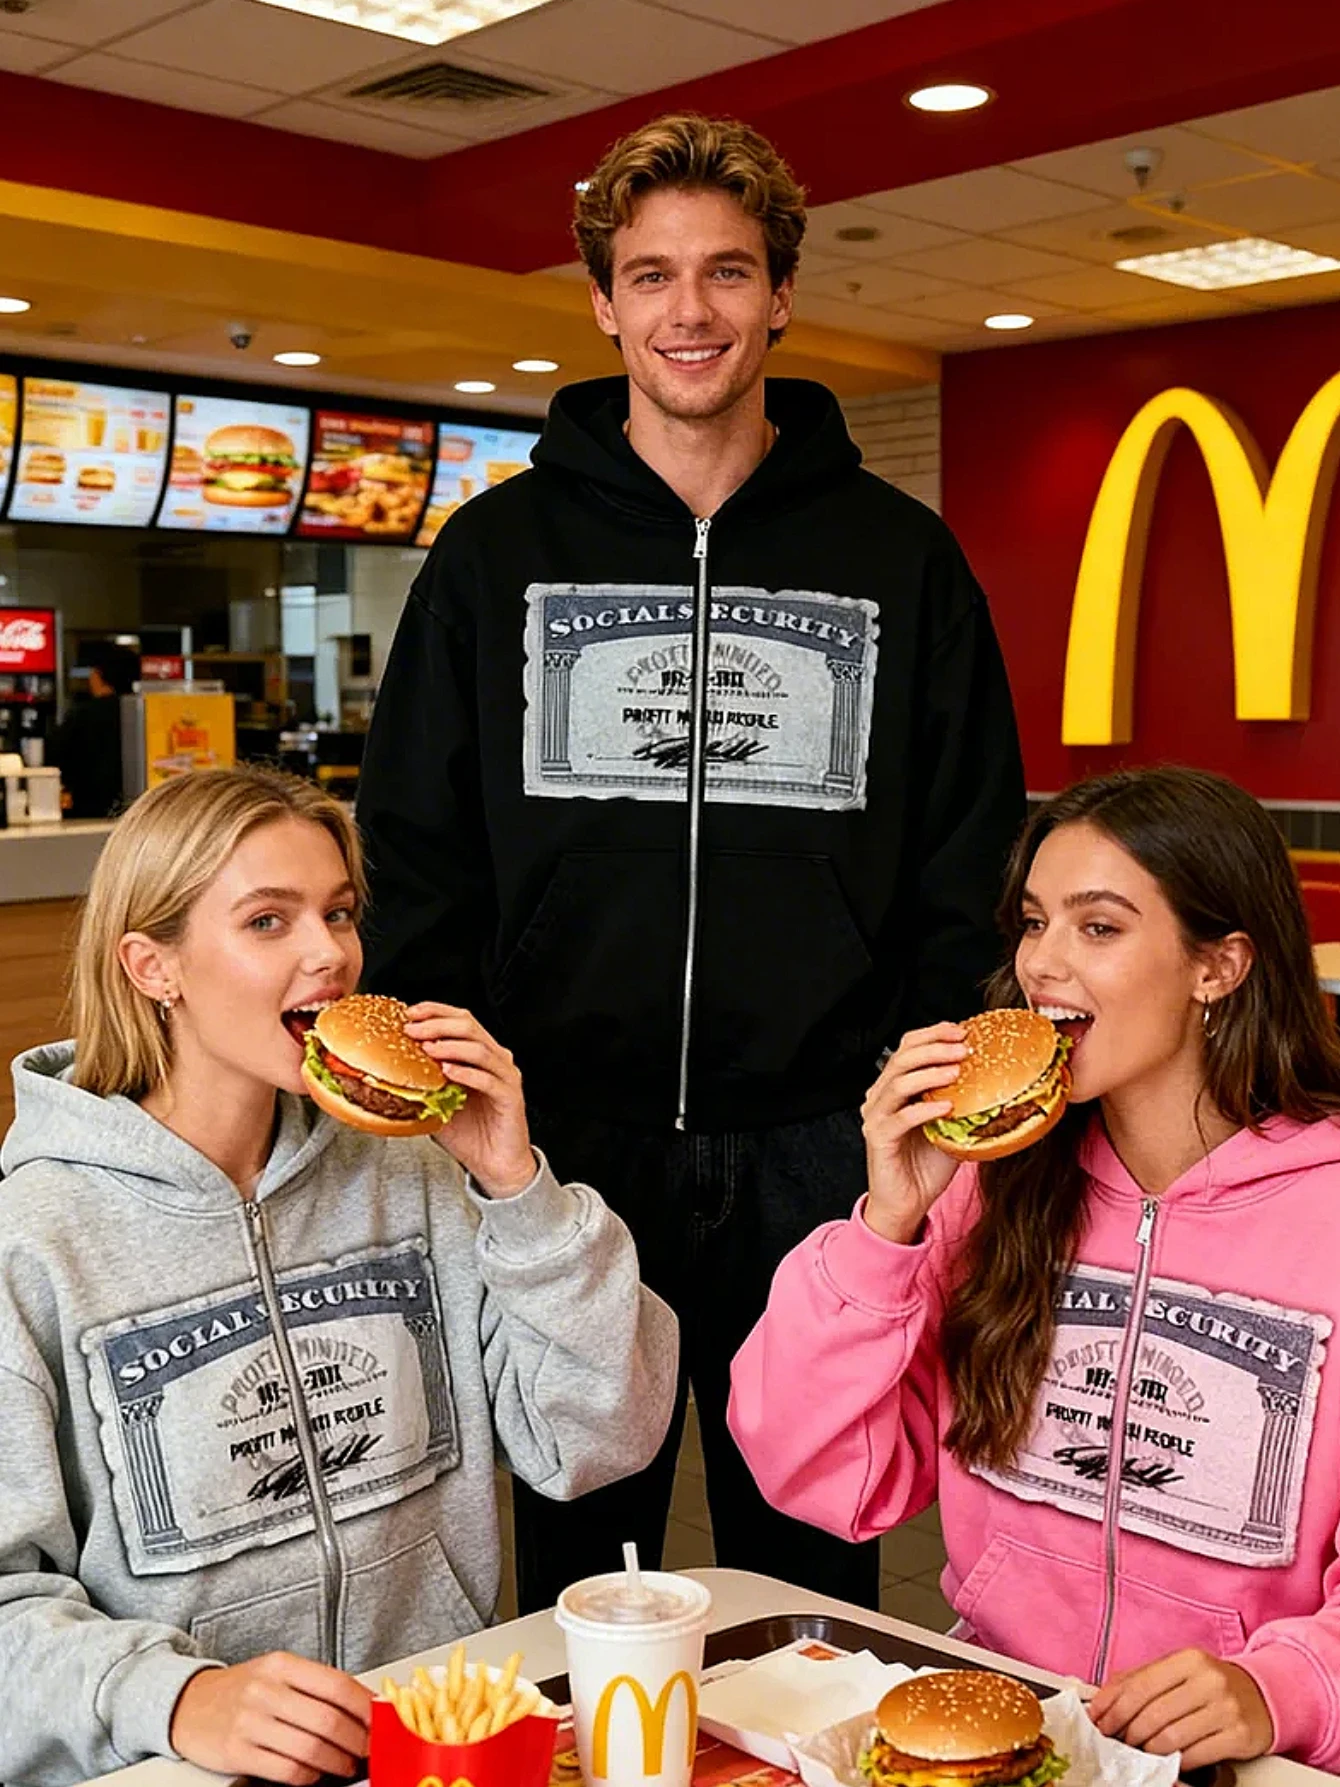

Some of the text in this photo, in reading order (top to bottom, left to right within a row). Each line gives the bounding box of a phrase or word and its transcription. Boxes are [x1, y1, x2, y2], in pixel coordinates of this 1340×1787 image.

[549, 602, 860, 649] SOCIAL SECURITY
[1056, 1290, 1116, 1311] IAL
[119, 1311, 252, 1387] SOCIAL
